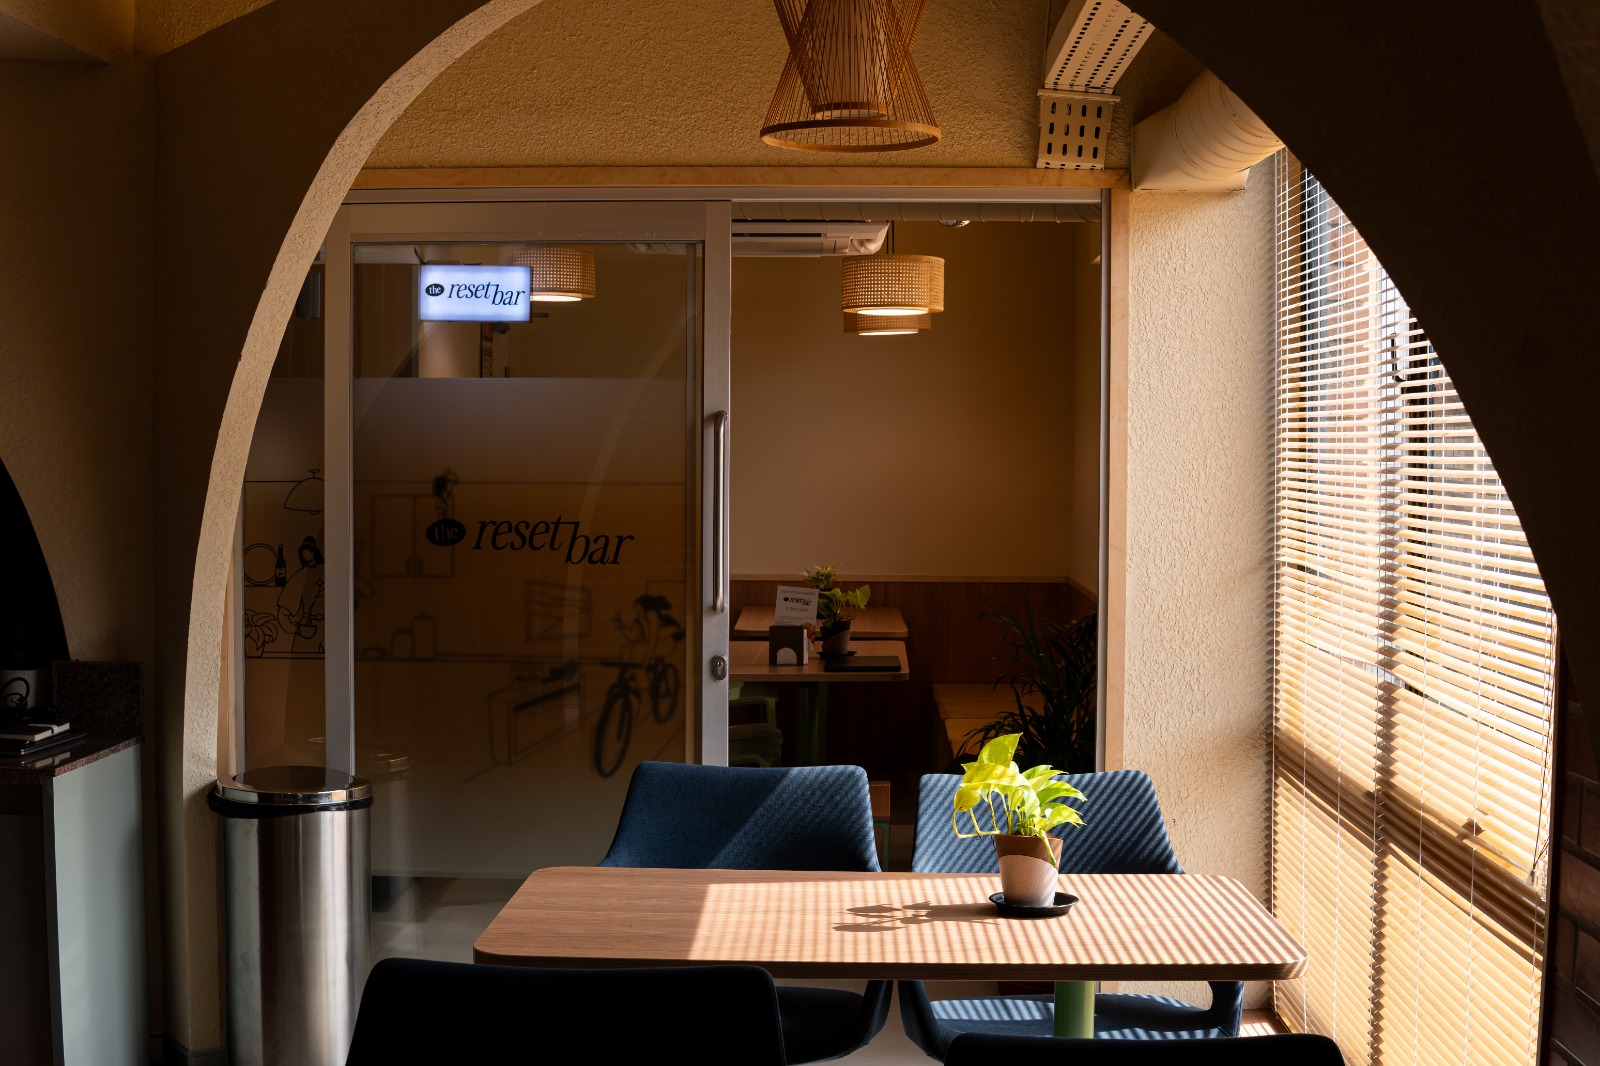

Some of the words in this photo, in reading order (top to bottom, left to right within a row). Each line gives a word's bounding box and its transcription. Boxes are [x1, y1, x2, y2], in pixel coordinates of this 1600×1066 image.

[427, 284, 443, 295] the
[447, 282, 493, 299] reset
[491, 284, 525, 305] bar
[432, 522, 460, 542] the
[470, 515, 564, 551] reset
[564, 521, 635, 565] bar
